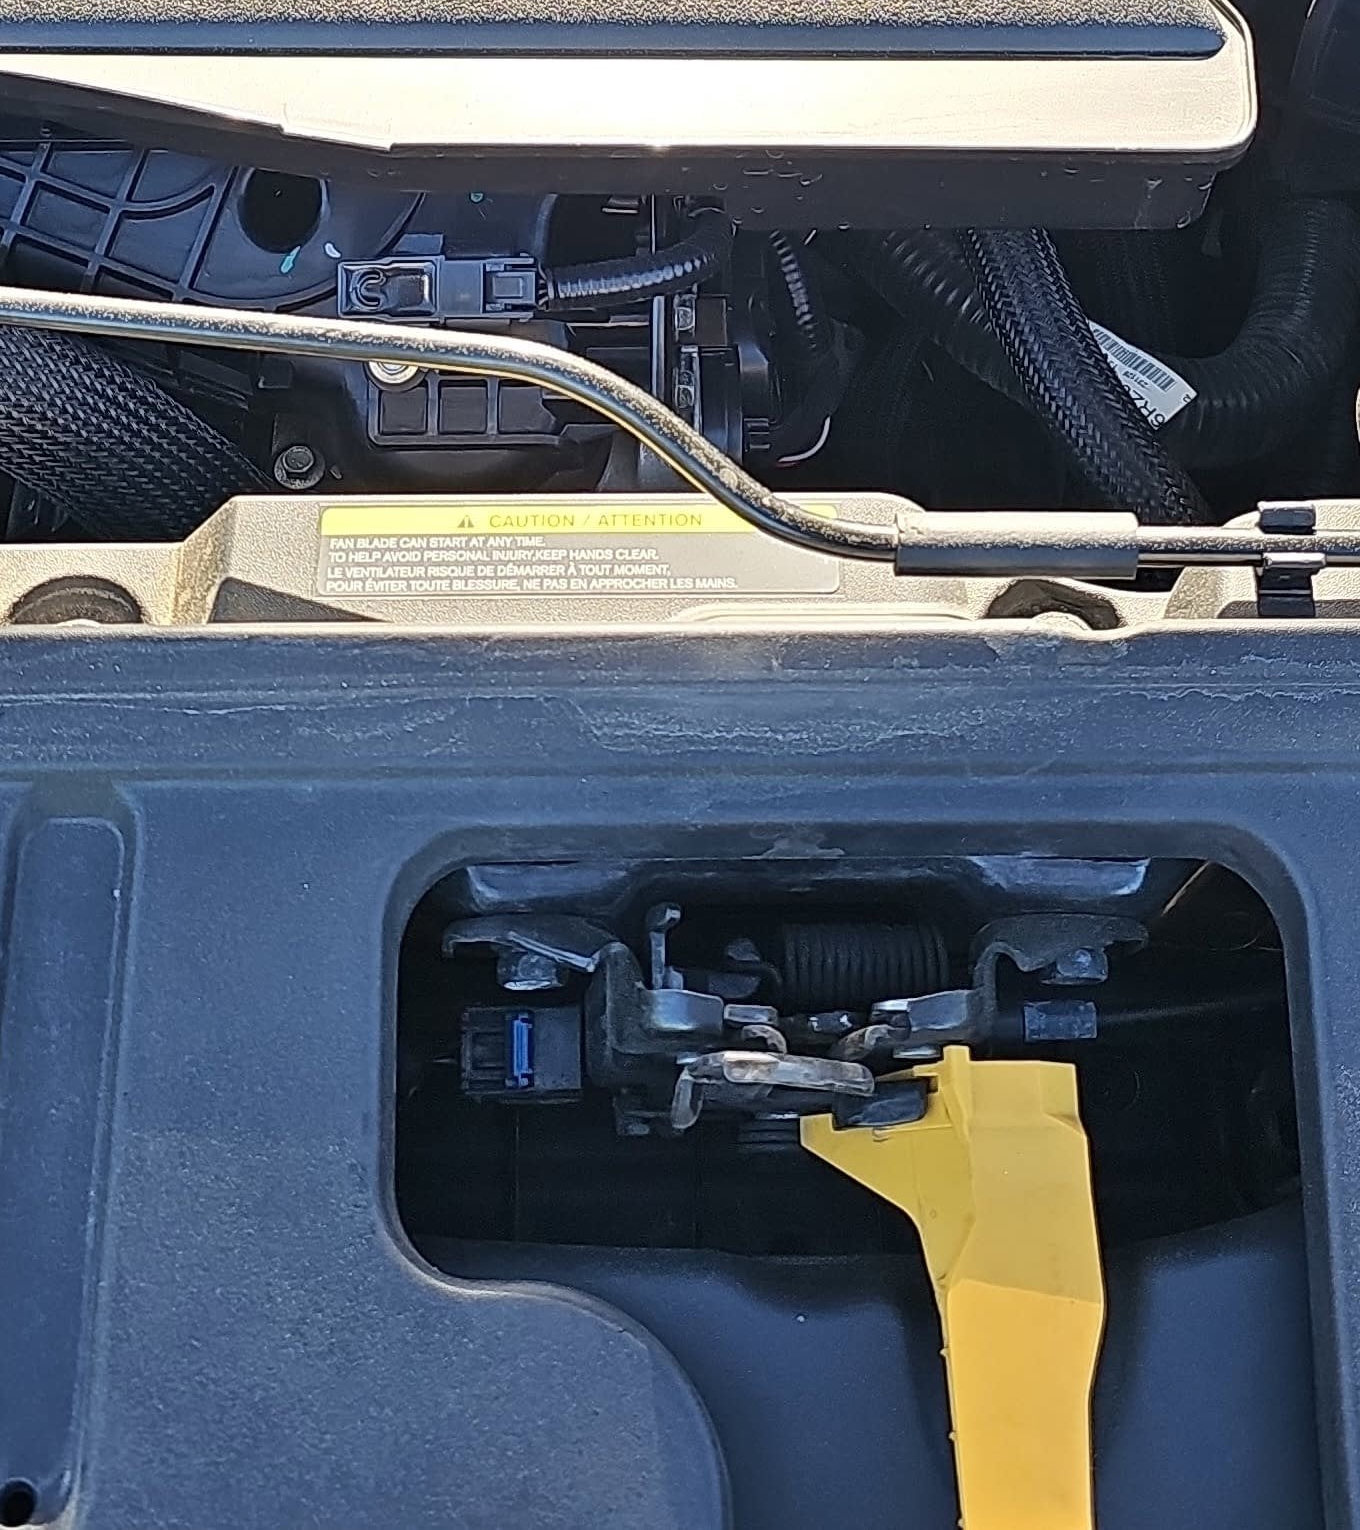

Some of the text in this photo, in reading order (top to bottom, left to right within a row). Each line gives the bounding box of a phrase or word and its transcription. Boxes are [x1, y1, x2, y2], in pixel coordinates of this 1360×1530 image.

[489, 514, 575, 528] CAUTION
[598, 513, 703, 527] ATTENTION
[330, 536, 546, 549] FAN BLADE CAN START AT ANY TIME.
[328, 551, 346, 563] TO
[348, 551, 381, 563] HELP
[382, 551, 421, 562] AVOID
[423, 550, 491, 562] PERSONAL
[569, 549, 613, 561] HANDS
[615, 548, 660, 560] CLEAR.
[327, 567, 343, 579] LE
[345, 566, 426, 578] VENTILATEUR
[427, 565, 476, 578] RISQUE
[477, 565, 496, 576] DE
[497, 562, 565, 576] DÉMARRER
[578, 564, 611, 576] TOUT
[613, 563, 671, 576] MOMENT,
[326, 577, 738, 592] POUR ÉVITER TOUTE BLESSURE, NE PAS EN APPROCHER LES MAINS.
